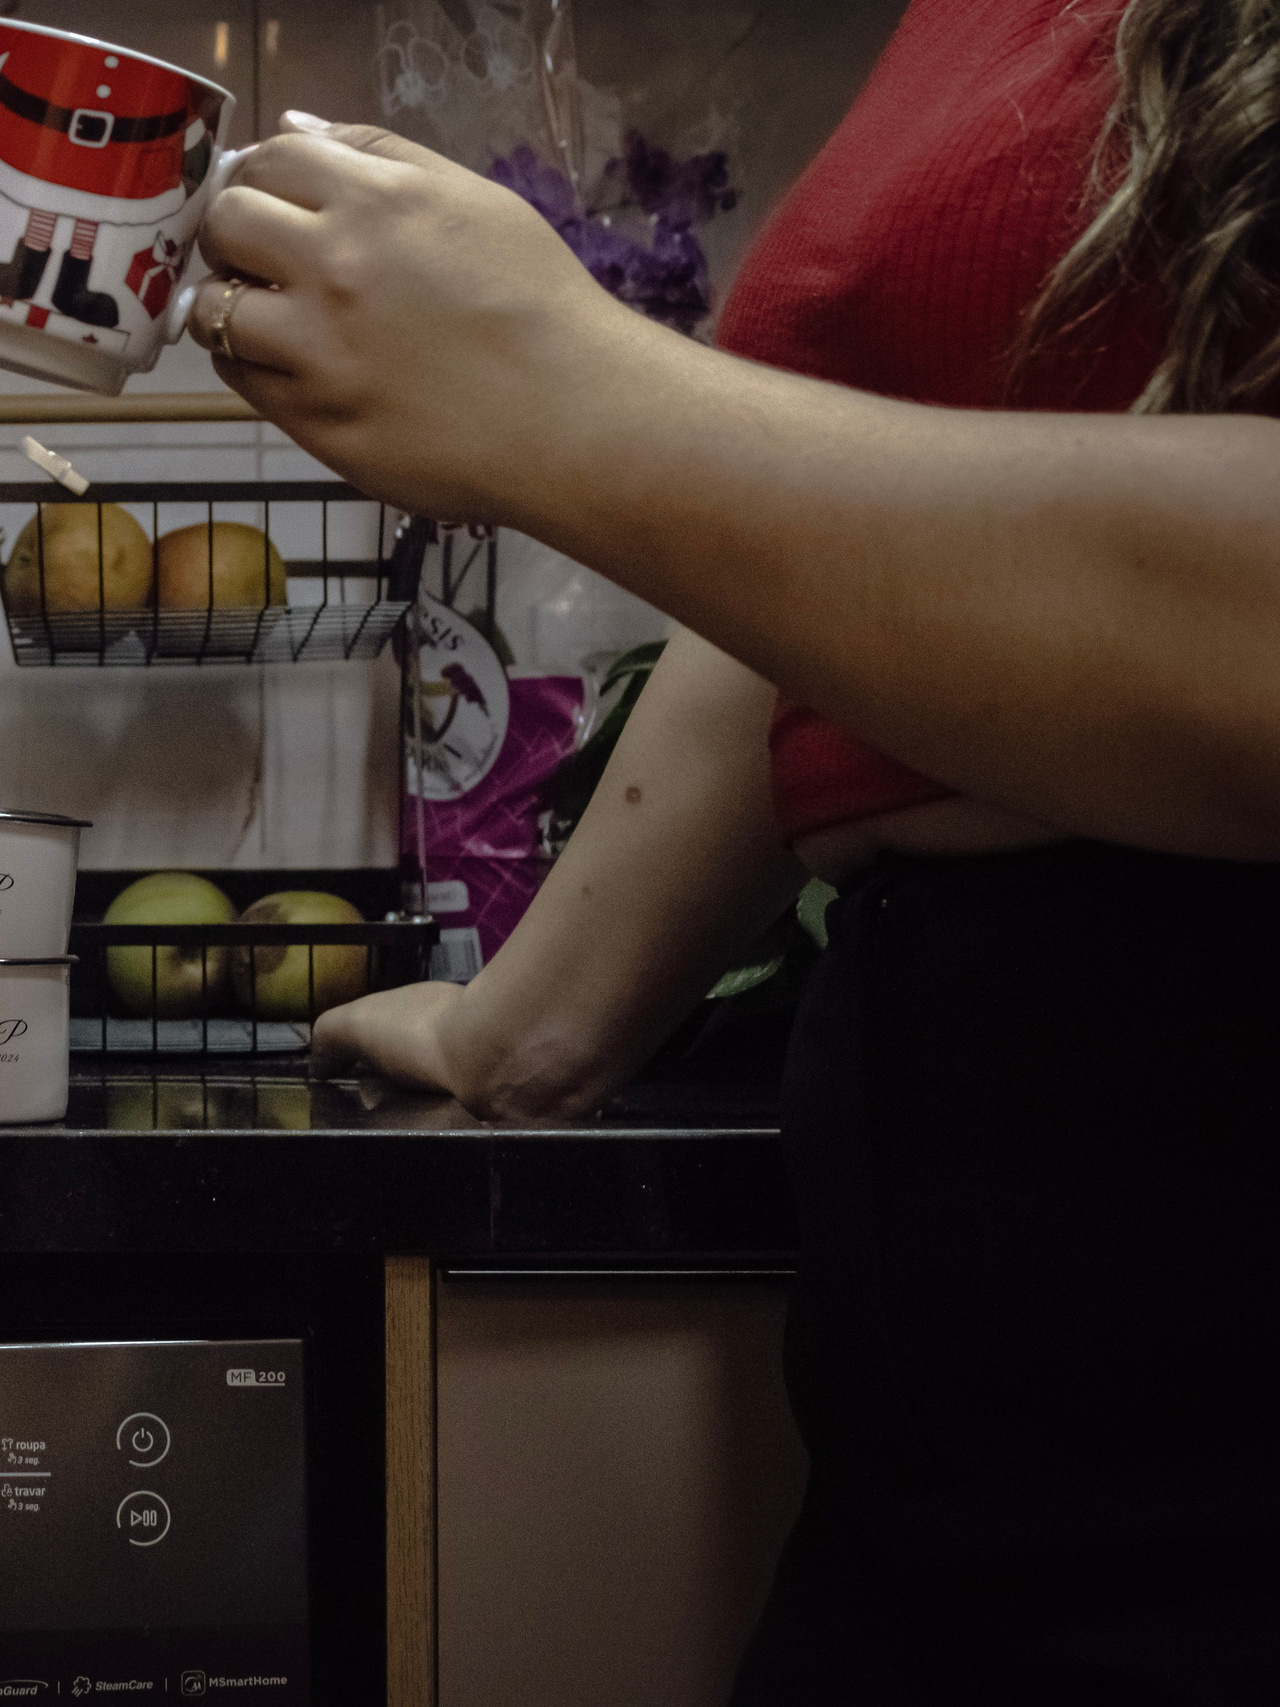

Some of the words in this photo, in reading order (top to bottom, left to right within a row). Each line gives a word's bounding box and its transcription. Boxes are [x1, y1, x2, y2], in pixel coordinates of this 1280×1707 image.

[230, 1372, 252, 1383] MF
[258, 1371, 286, 1382] 200
[16, 1440, 46, 1452] roupa
[14, 1486, 46, 1496] travar
[95, 1680, 154, 1692] SteamCare
[208, 1676, 288, 1687] MSmartHome
